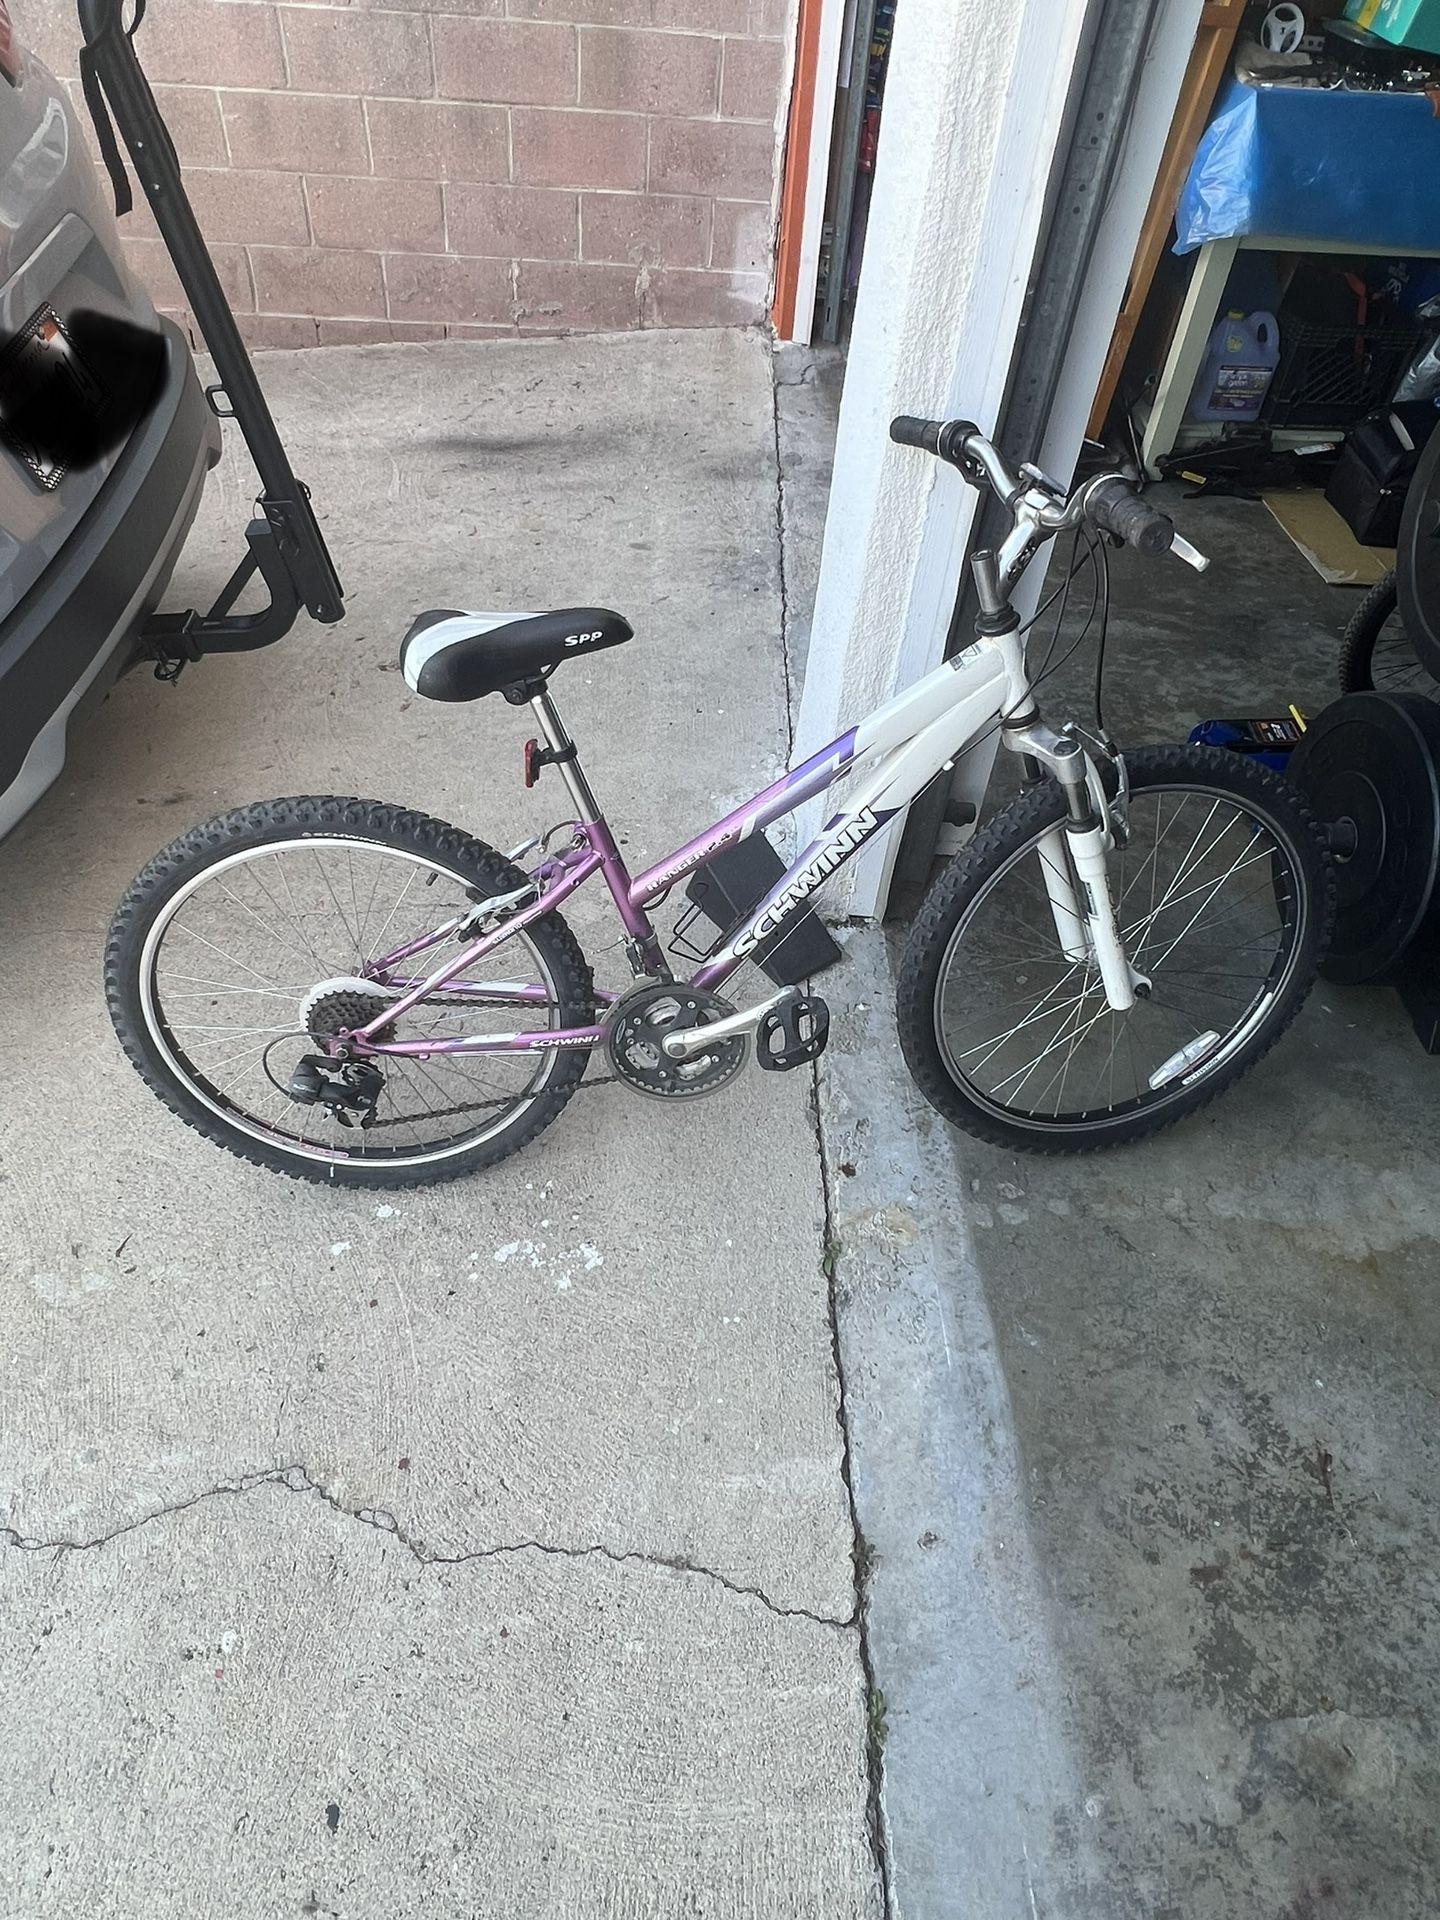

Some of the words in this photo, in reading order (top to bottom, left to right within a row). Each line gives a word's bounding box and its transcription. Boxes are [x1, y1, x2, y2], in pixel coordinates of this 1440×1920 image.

[564, 631, 603, 647] SPP
[646, 849, 706, 891] RANGER
[733, 805, 878, 959] SCHWINN
[529, 1035, 599, 1048] SCHWINN
